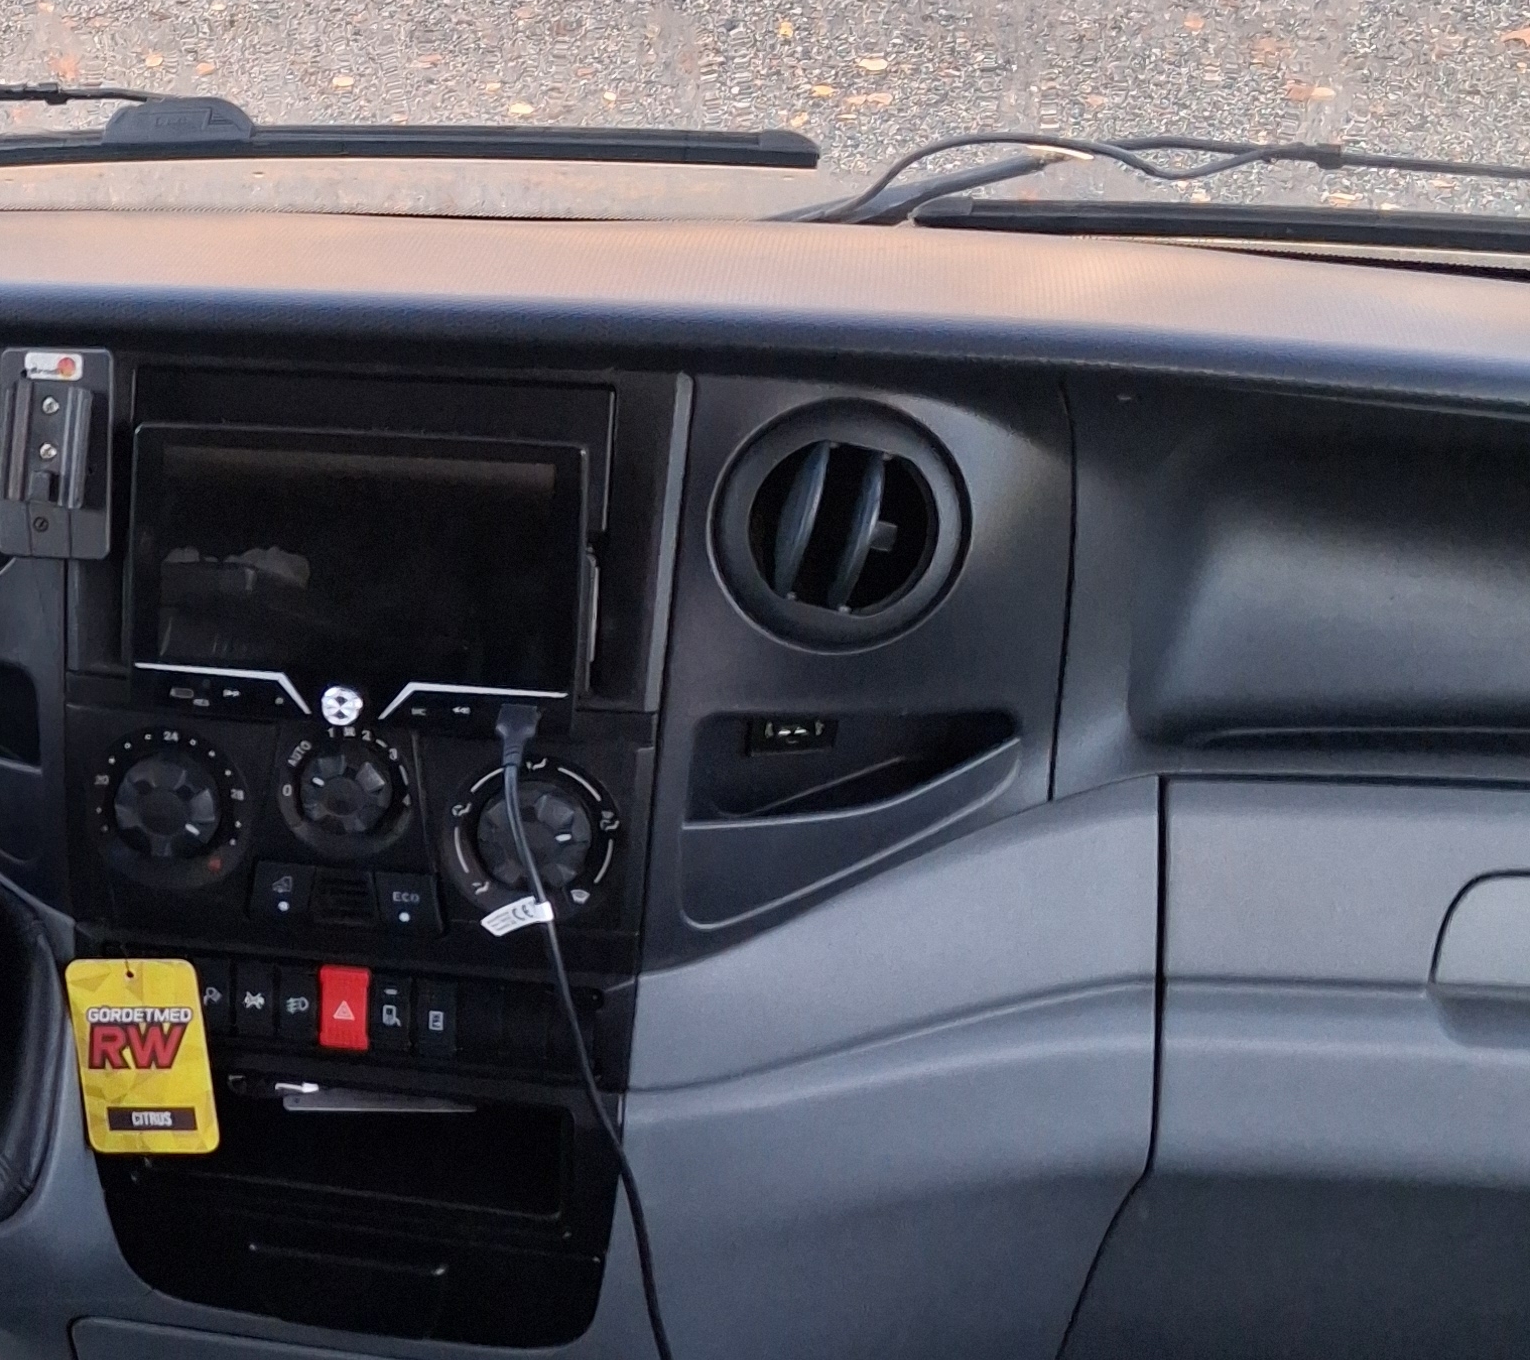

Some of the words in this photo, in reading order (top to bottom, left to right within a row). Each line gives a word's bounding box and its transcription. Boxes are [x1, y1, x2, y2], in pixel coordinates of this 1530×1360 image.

[163, 731, 179, 742] 24
[361, 729, 372, 742] 2
[287, 740, 312, 767] AUTO
[282, 784, 292, 797] 0
[392, 891, 419, 903] ECO
[88, 1023, 189, 1070] RW
[131, 1111, 173, 1127] CITRUS
